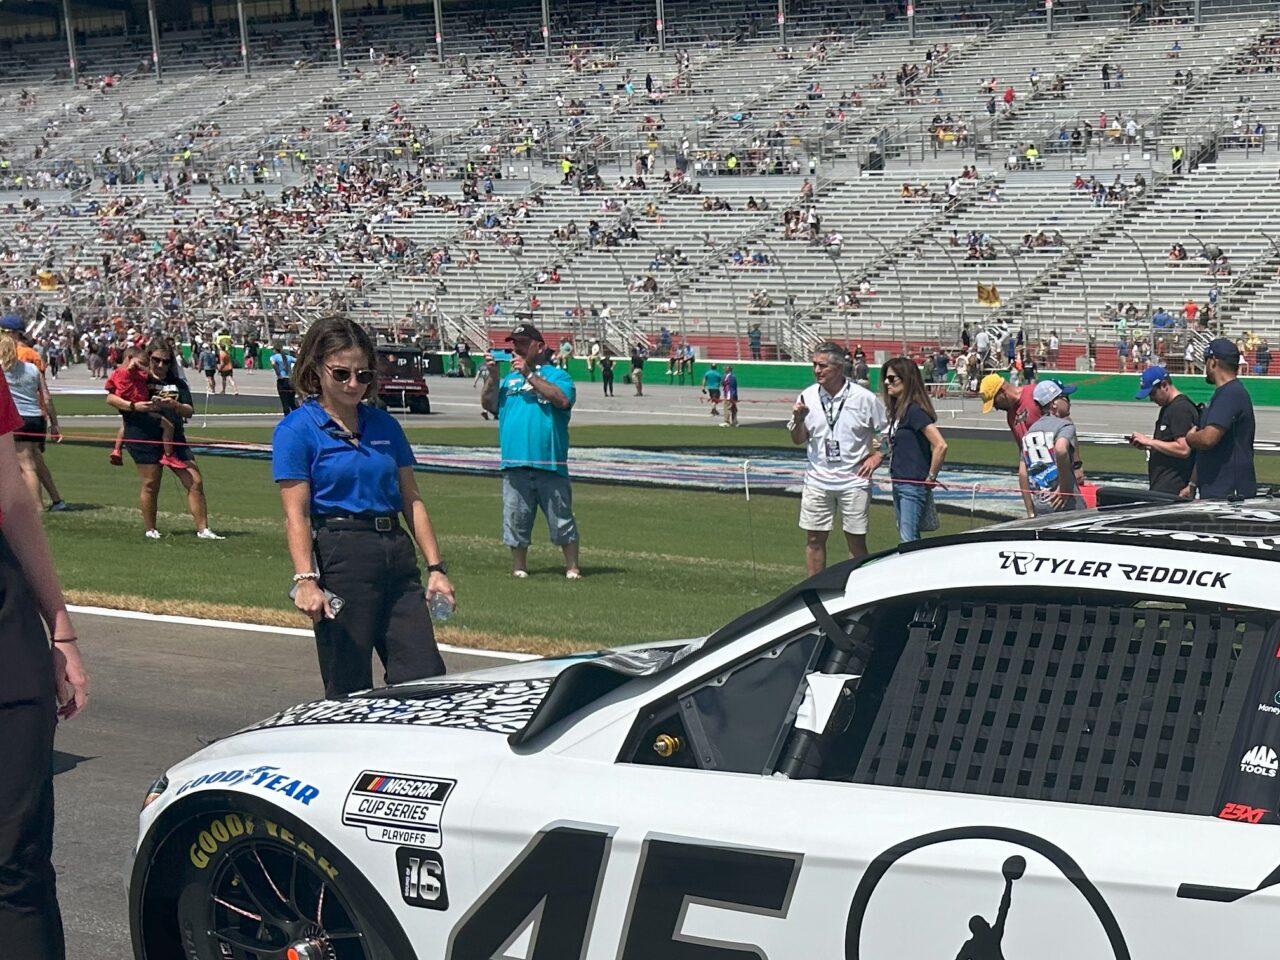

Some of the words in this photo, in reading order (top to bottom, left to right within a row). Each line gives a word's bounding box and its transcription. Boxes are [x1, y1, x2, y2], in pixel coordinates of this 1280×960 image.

[1034, 557, 1112, 578] TYLER
[1117, 562, 1232, 588] REDDICK
[1240, 745, 1279, 770] MAC
[1240, 763, 1278, 777] TOOLS
[381, 777, 440, 798] NASCAR
[357, 798, 384, 816] CUP
[384, 801, 429, 821] SERIES
[381, 828, 427, 844] PLAYOFFS
[409, 857, 443, 901] 16
